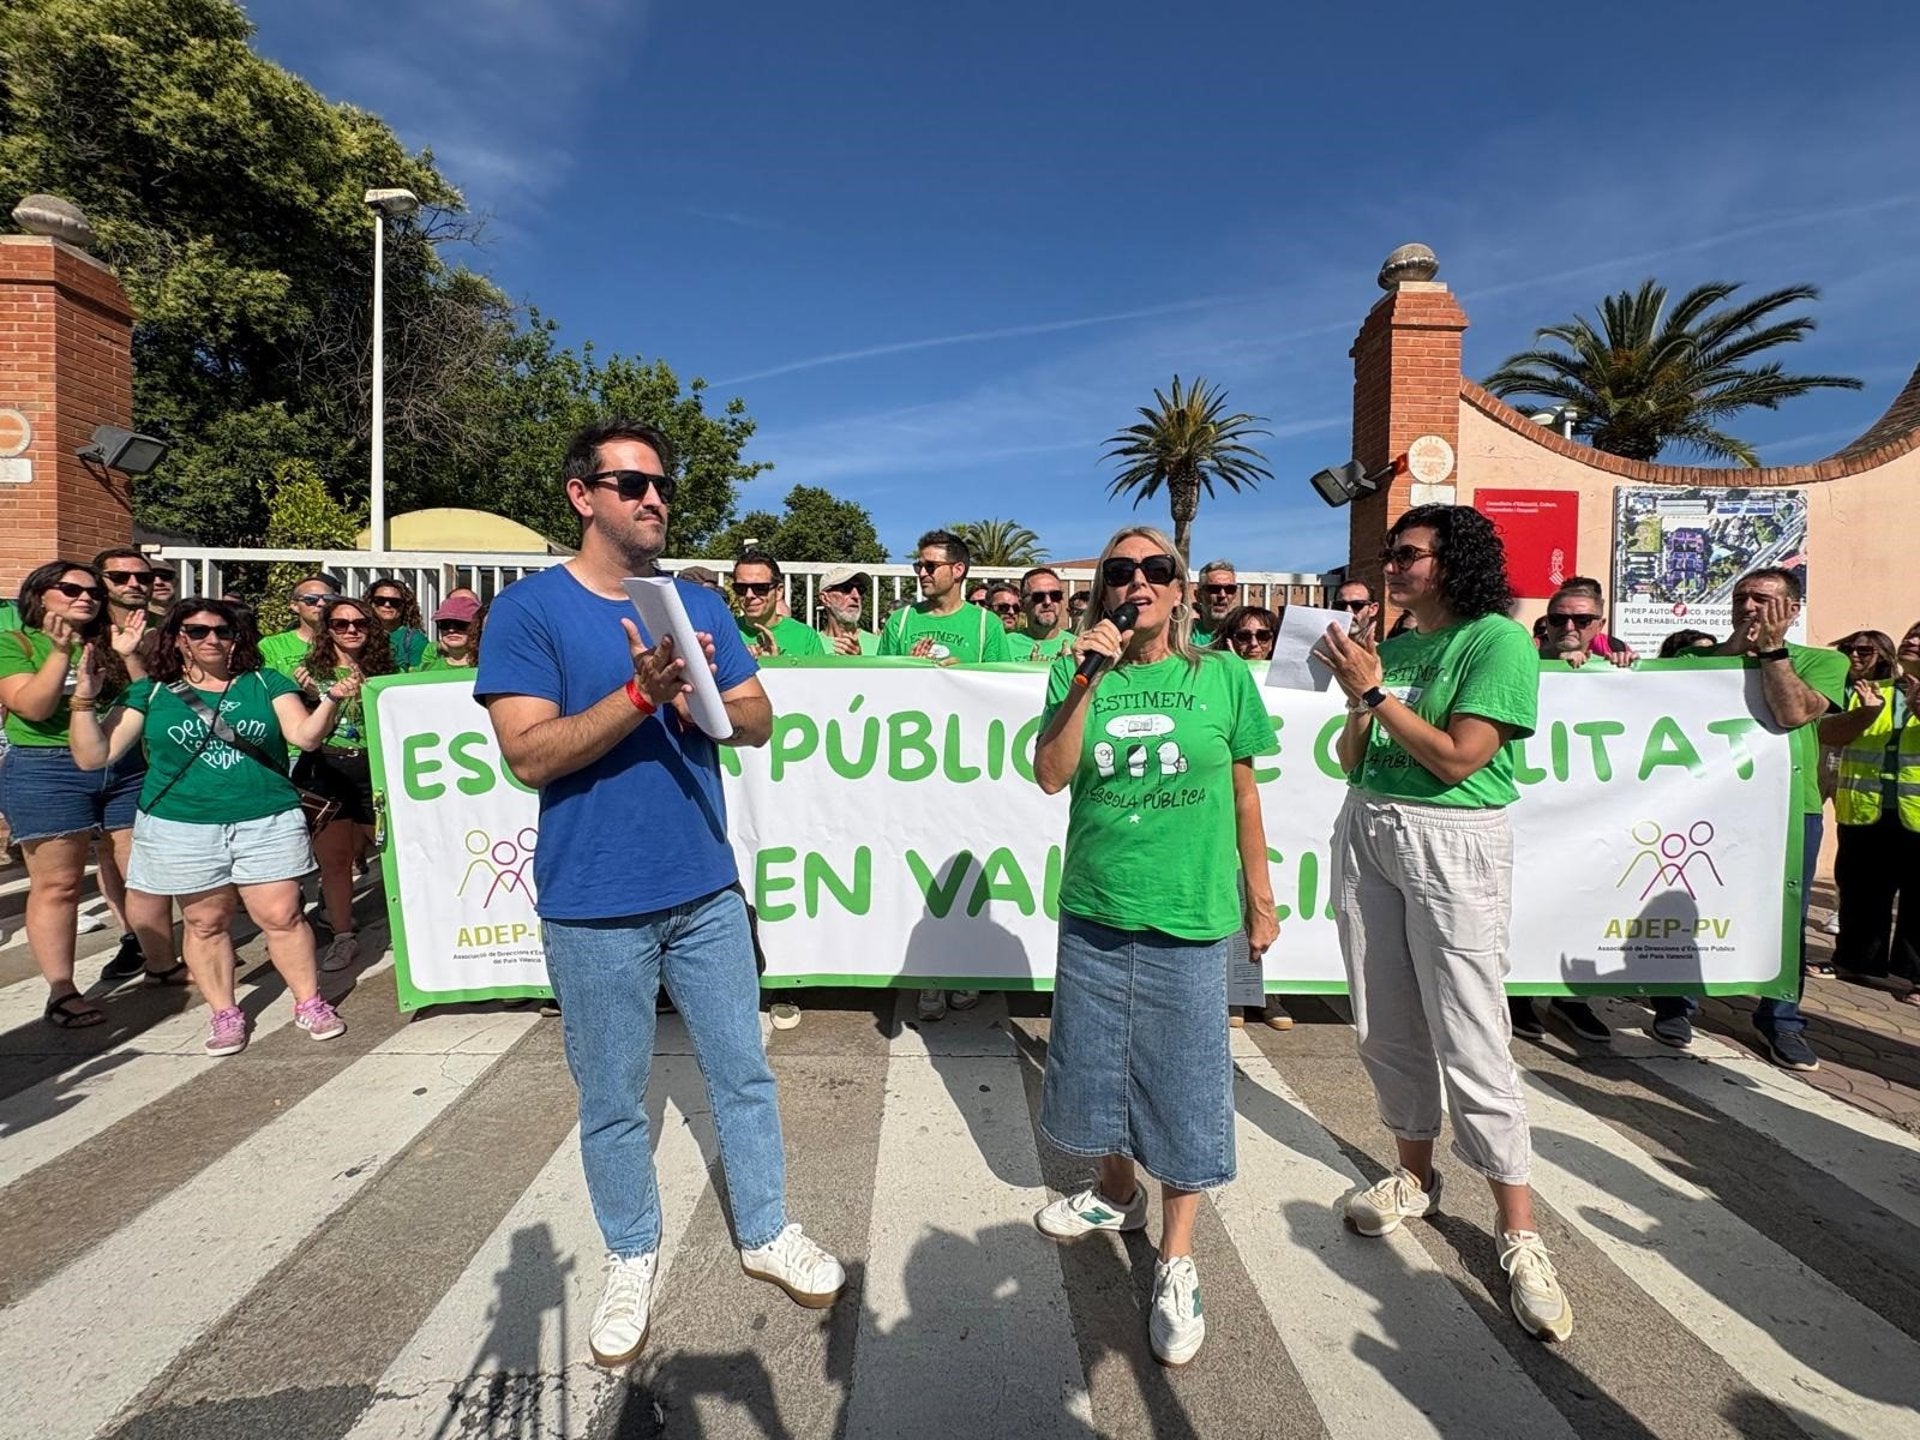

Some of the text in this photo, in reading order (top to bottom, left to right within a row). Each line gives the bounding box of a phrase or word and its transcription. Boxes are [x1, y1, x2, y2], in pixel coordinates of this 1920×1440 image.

[1092, 691, 1197, 715] ESTIMEM
[1143, 787, 1206, 809] PÚBLICA
[755, 845, 872, 922] EN
[1604, 919, 1730, 939] ADEP-PV
